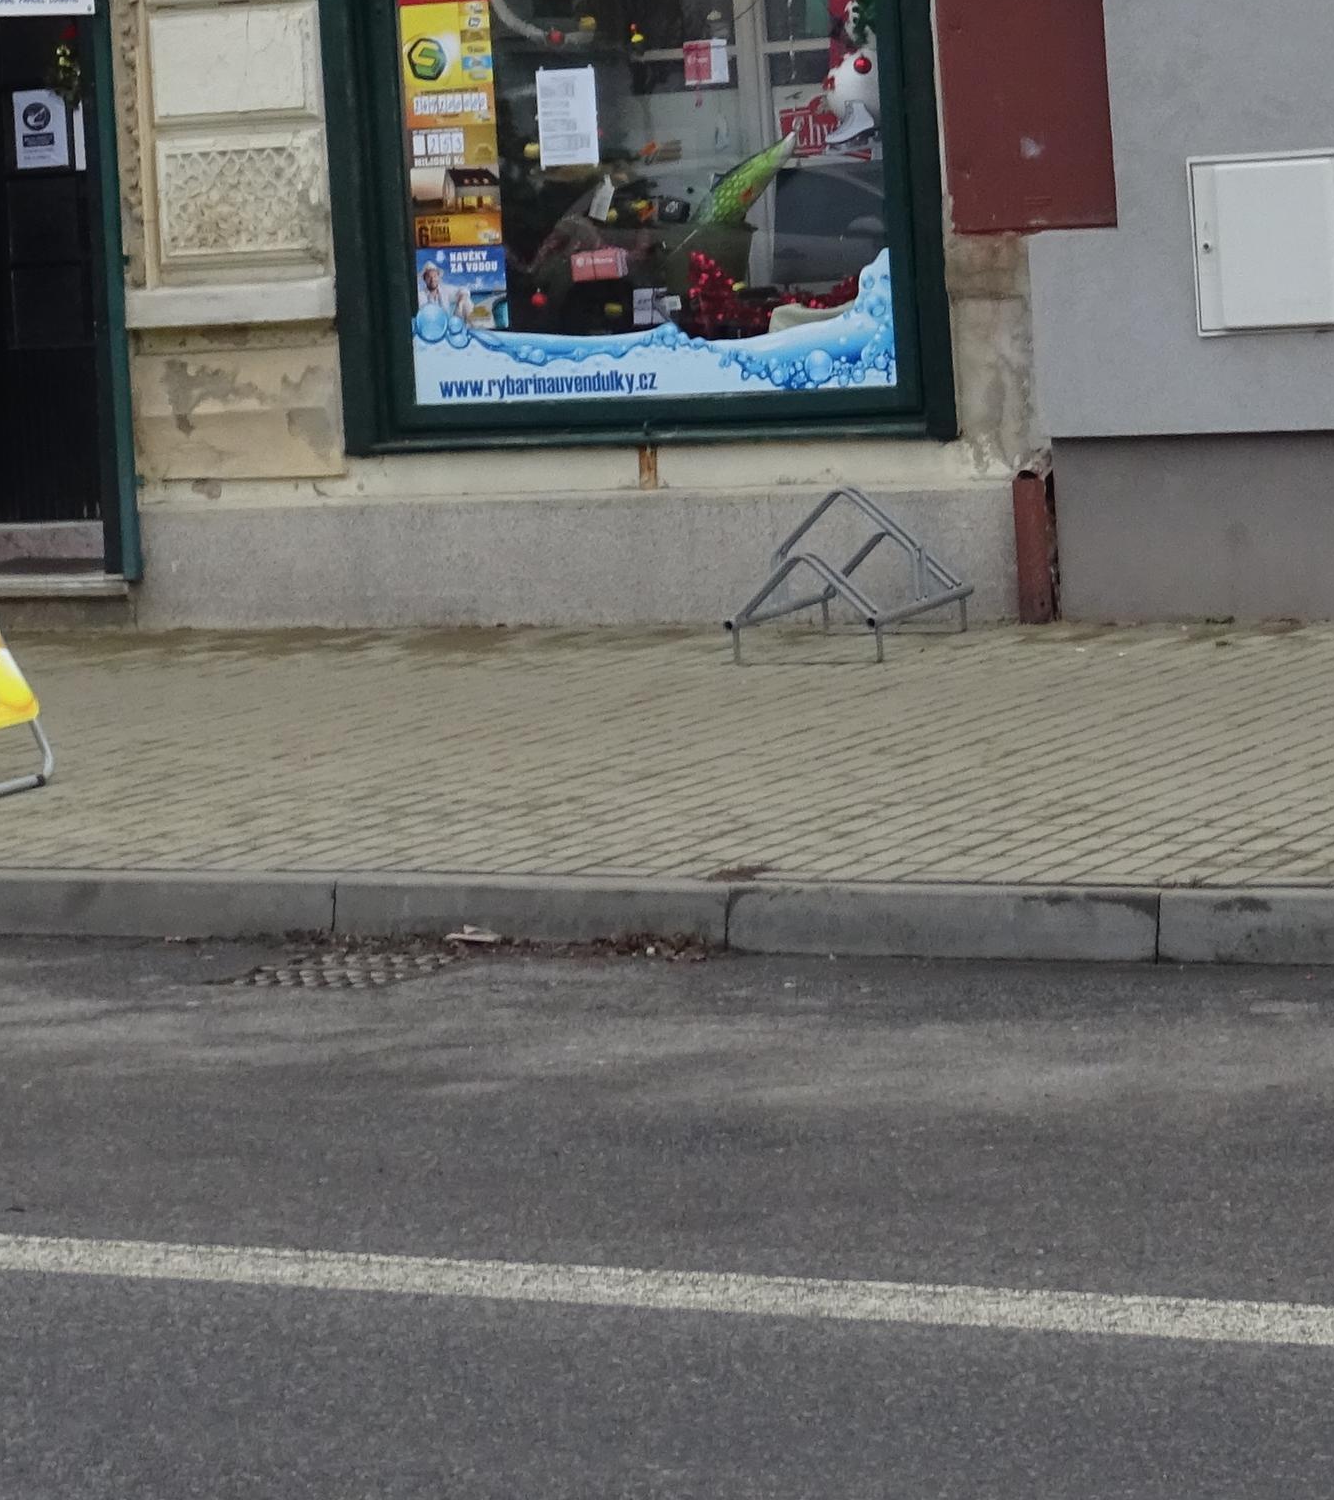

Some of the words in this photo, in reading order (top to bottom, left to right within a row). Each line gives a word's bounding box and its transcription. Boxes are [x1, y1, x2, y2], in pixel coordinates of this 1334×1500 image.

[449, 250, 487, 262] NAVĚKY
[450, 262, 464, 273] ZA
[466, 261, 498, 272] VODOU
[439, 369, 658, 399] www.rybarinauvendulky.cz
